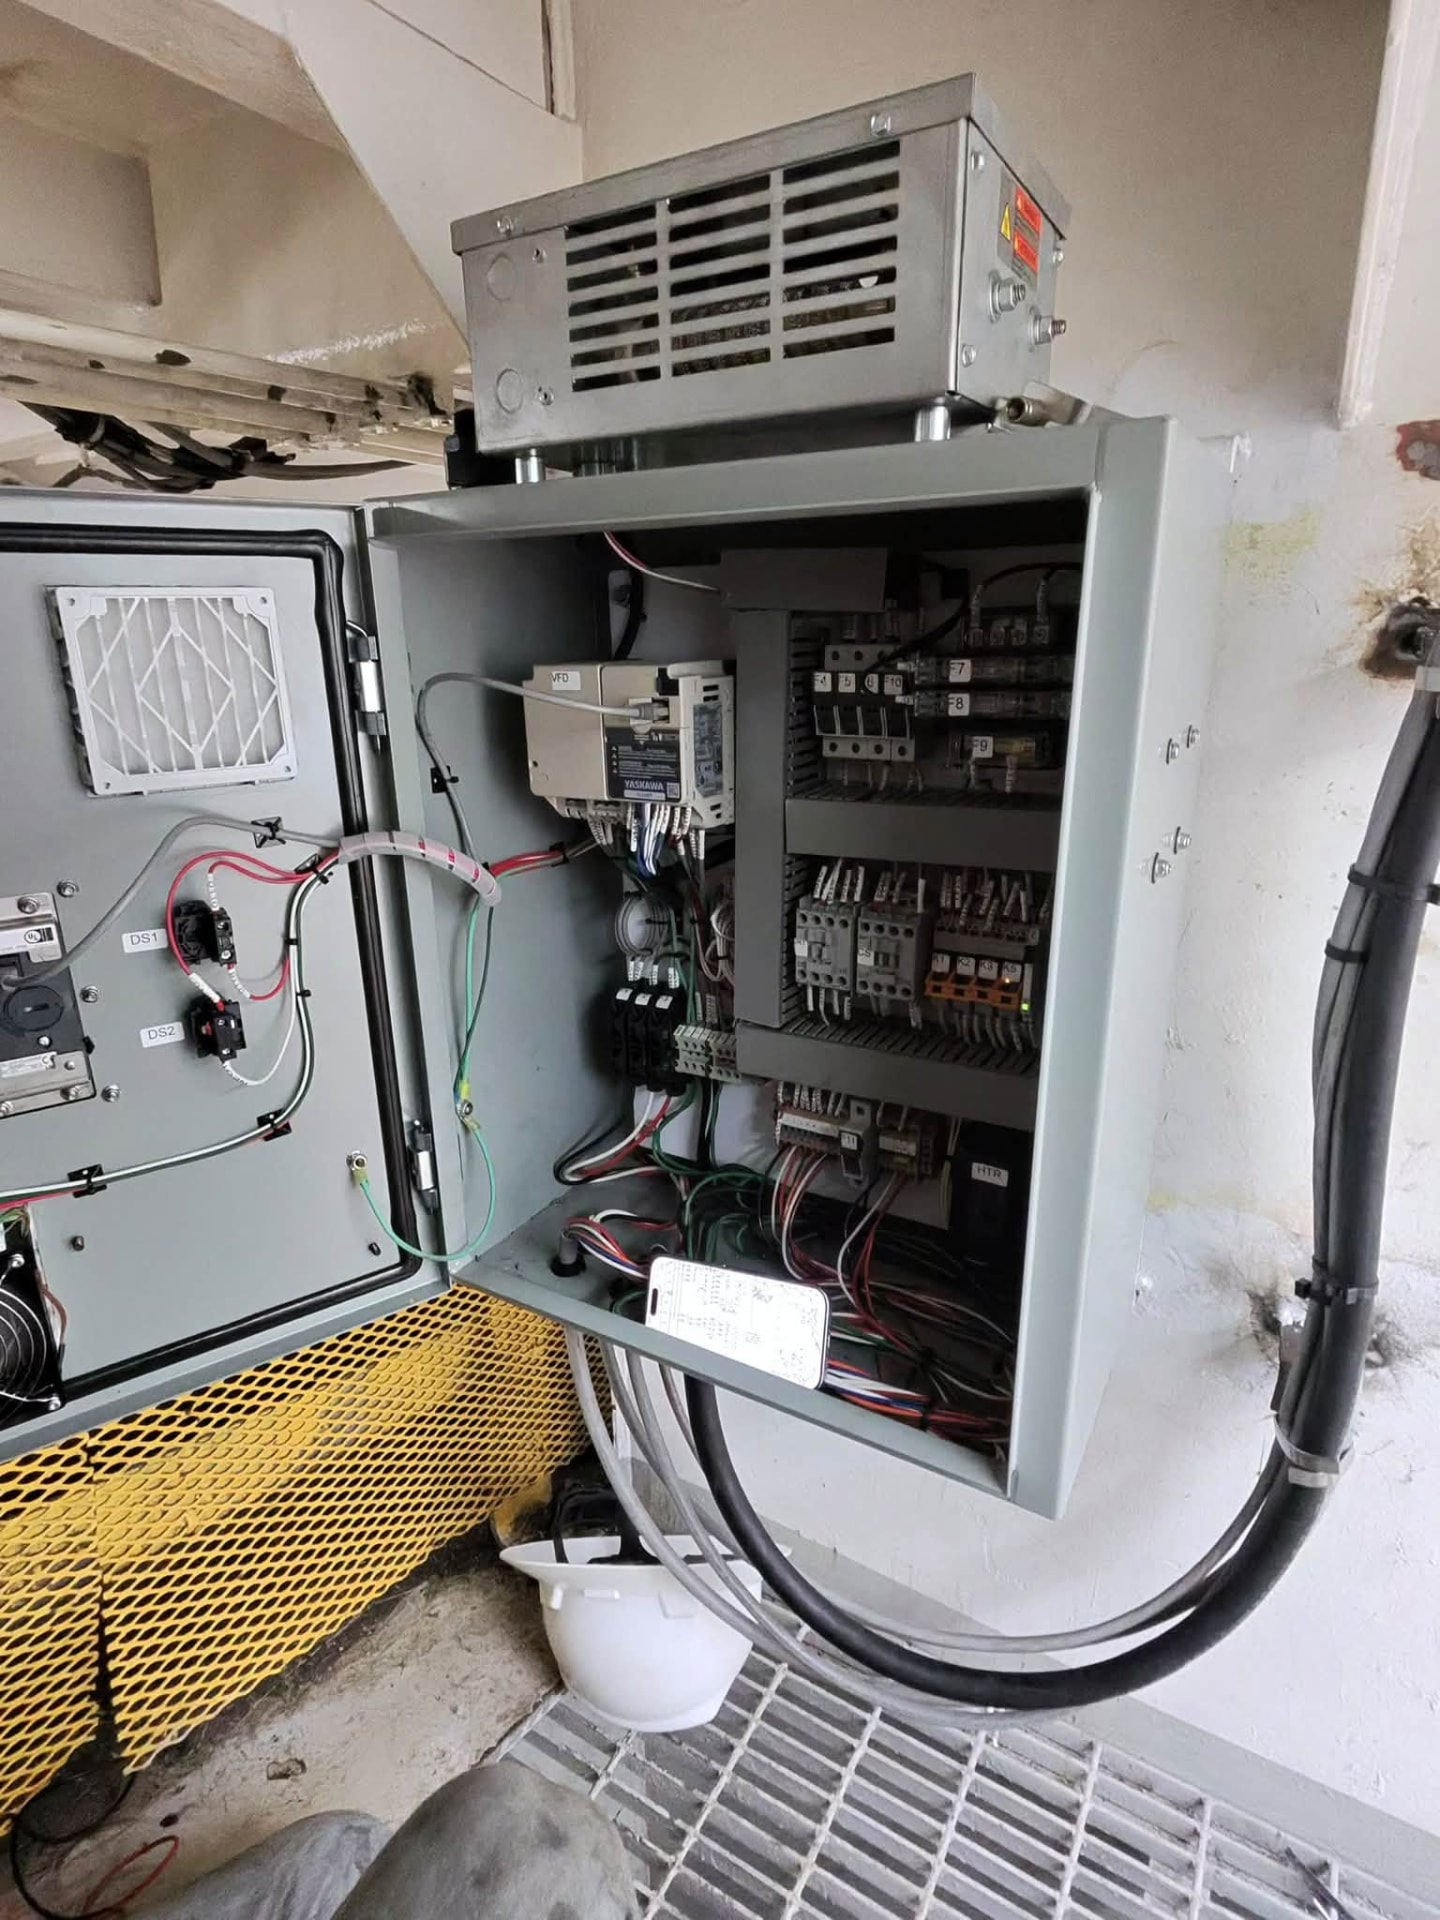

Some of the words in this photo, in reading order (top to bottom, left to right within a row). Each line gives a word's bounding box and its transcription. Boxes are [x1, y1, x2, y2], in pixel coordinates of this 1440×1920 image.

[550, 673, 569, 683] VFD
[948, 697, 964, 710] F8
[624, 780, 665, 791] YASKAWA
[130, 932, 158, 946] DS1
[147, 1025, 175, 1040] DS2
[977, 1164, 1001, 1178] HTR
